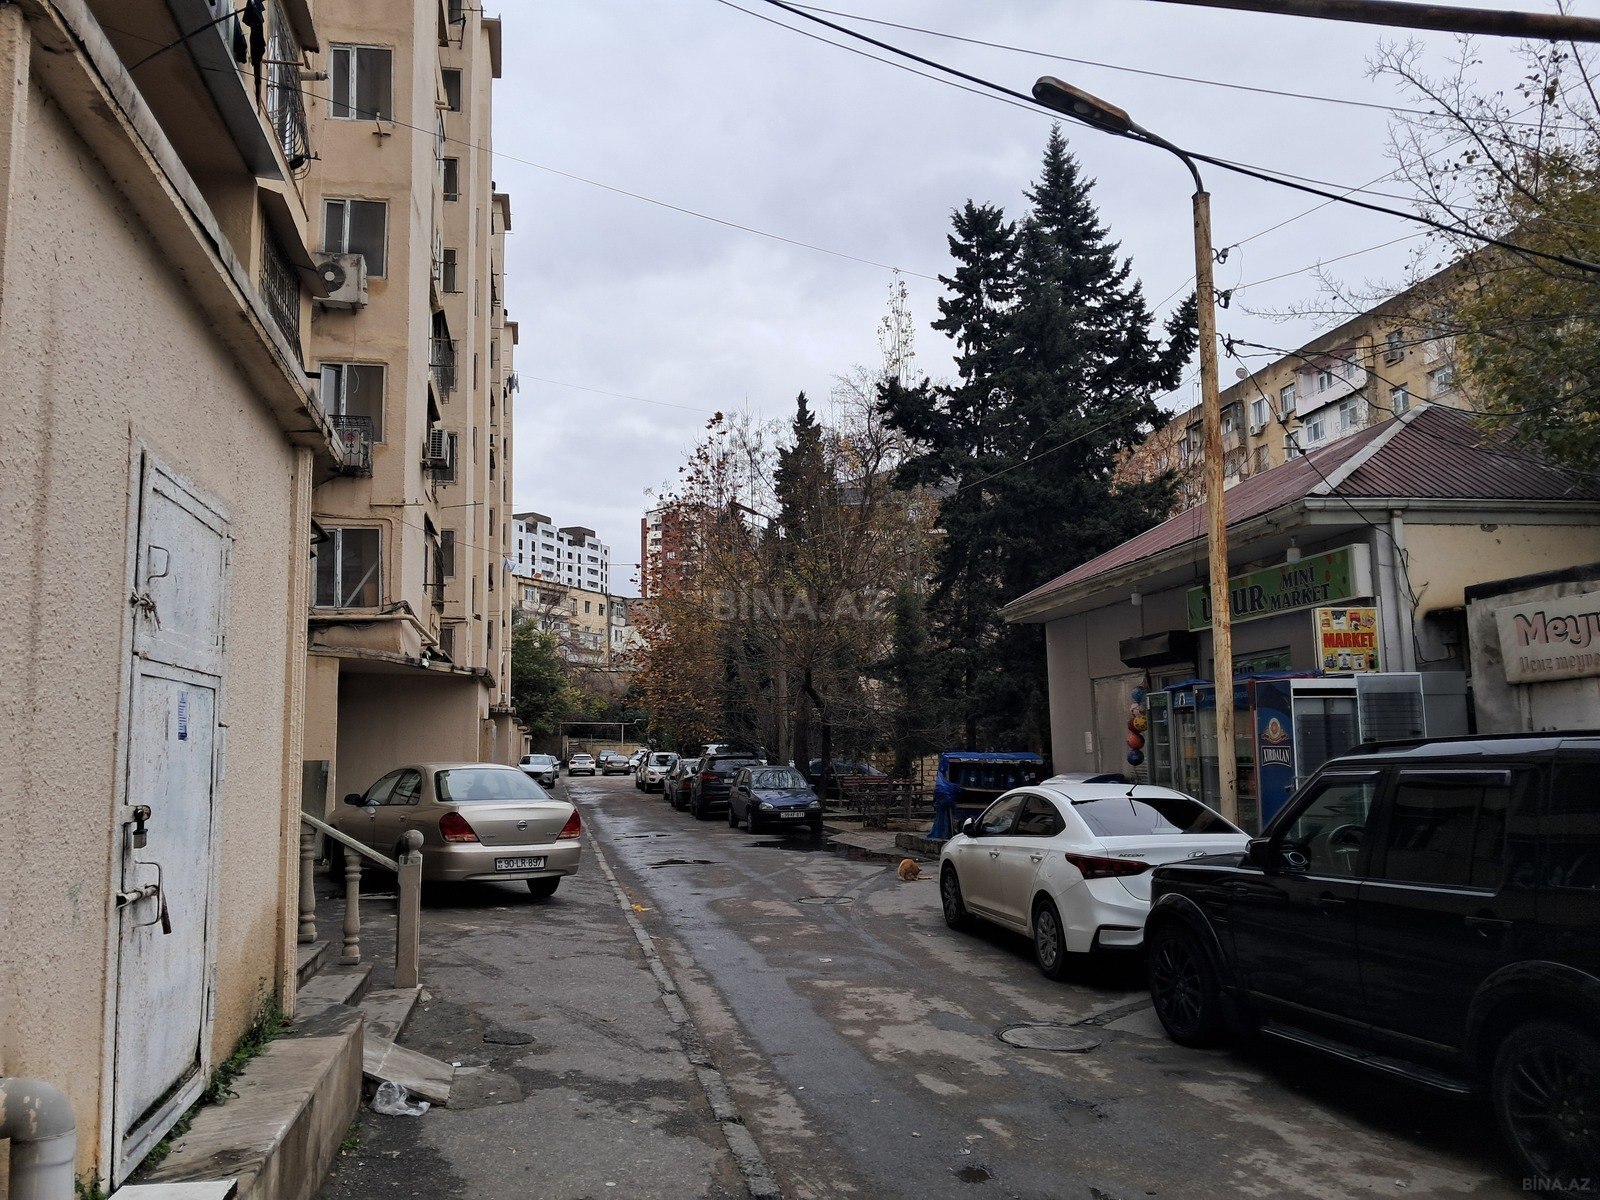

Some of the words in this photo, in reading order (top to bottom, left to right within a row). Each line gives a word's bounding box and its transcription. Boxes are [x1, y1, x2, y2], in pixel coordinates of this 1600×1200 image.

[1270, 583, 1330, 611] MARKET
[1323, 632, 1375, 648] MARKET
[504, 858, 542, 868] 90-LR-897
